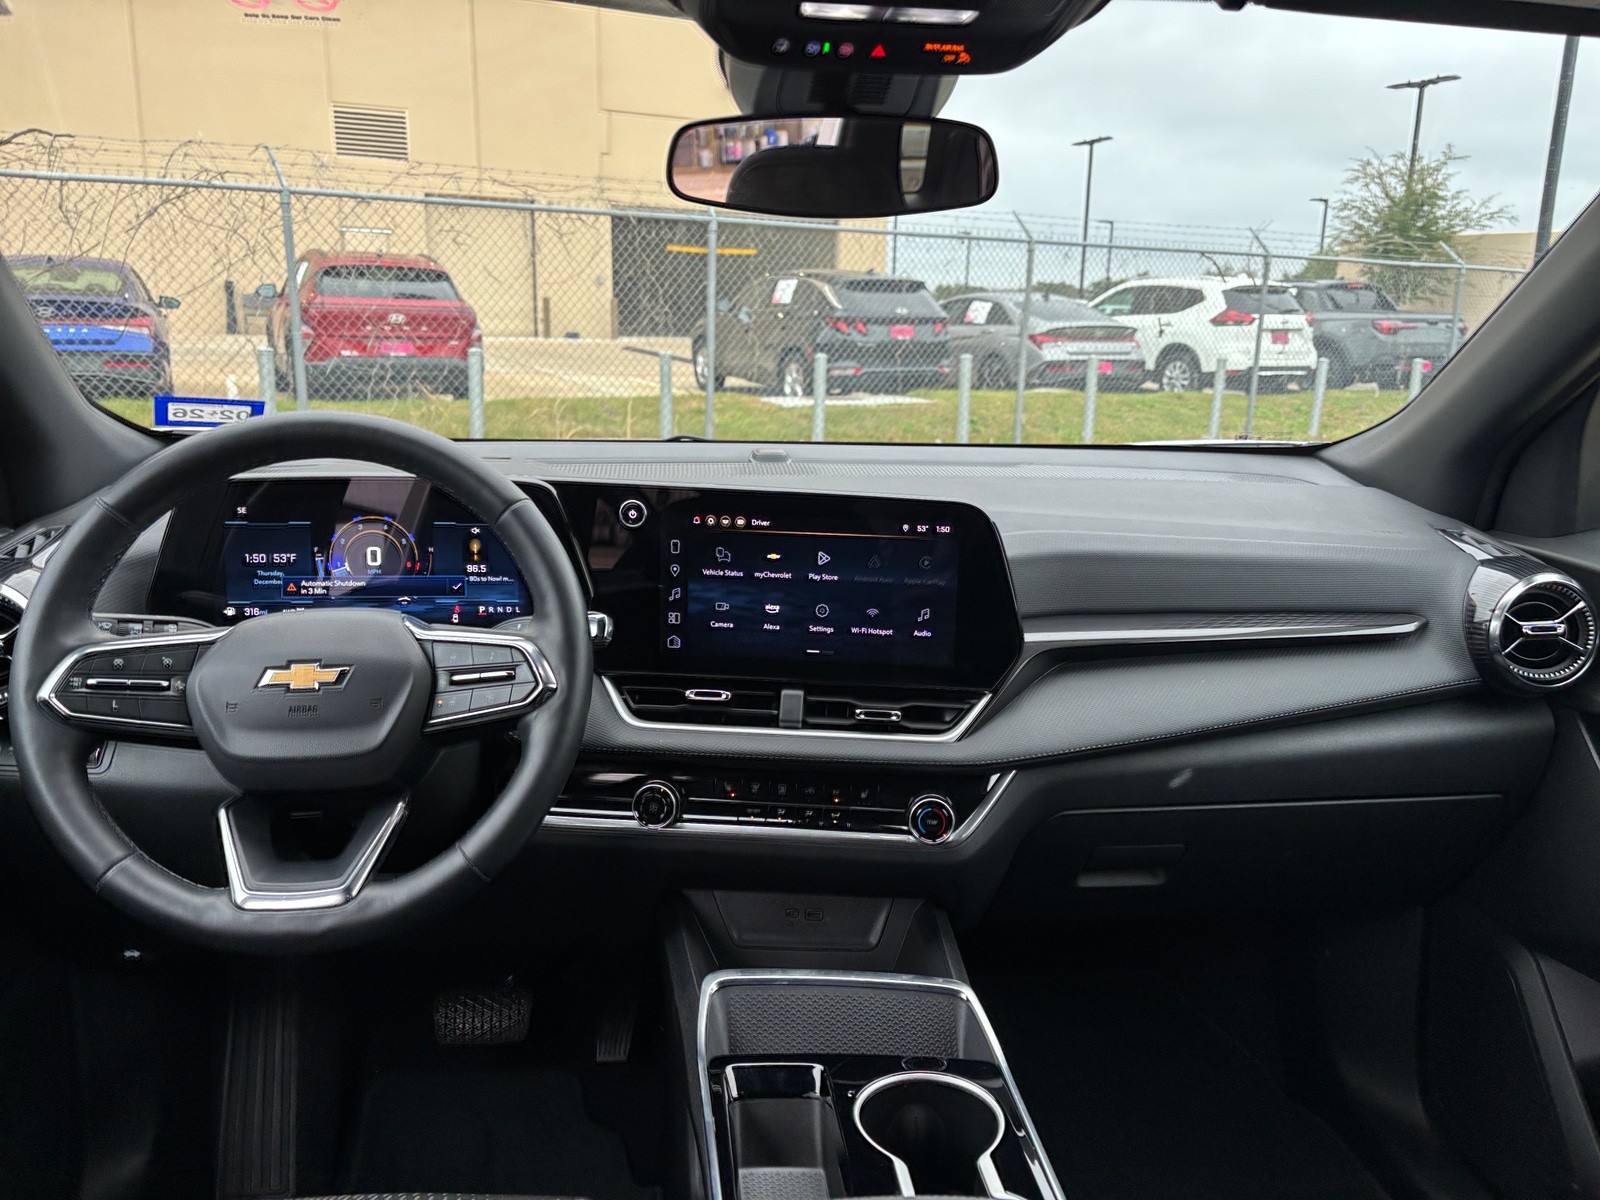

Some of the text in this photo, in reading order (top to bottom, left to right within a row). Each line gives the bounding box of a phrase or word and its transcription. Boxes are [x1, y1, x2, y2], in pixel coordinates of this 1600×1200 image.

[236, 506, 247, 514] SE
[751, 518, 771, 527] Driver
[936, 525, 951, 533] 1:50
[244, 553, 267, 563] 1:50
[273, 553, 297, 563] 53°F
[366, 546, 382, 566] 0
[466, 564, 487, 573] 96.5
[702, 568, 744, 577] Vehicle Status
[754, 571, 792, 580] myChevrolet
[808, 573, 839, 581] Play Store
[301, 580, 366, 588] Automatic Shutdown
[243, 607, 260, 616] 316
[710, 620, 734, 629] Camera
[763, 623, 780, 631] Alexa
[809, 625, 834, 633] Settings
[868, 628, 893, 637] Hotspot
[913, 630, 932, 638] Audio
[288, 704, 318, 716] AIRBAG
